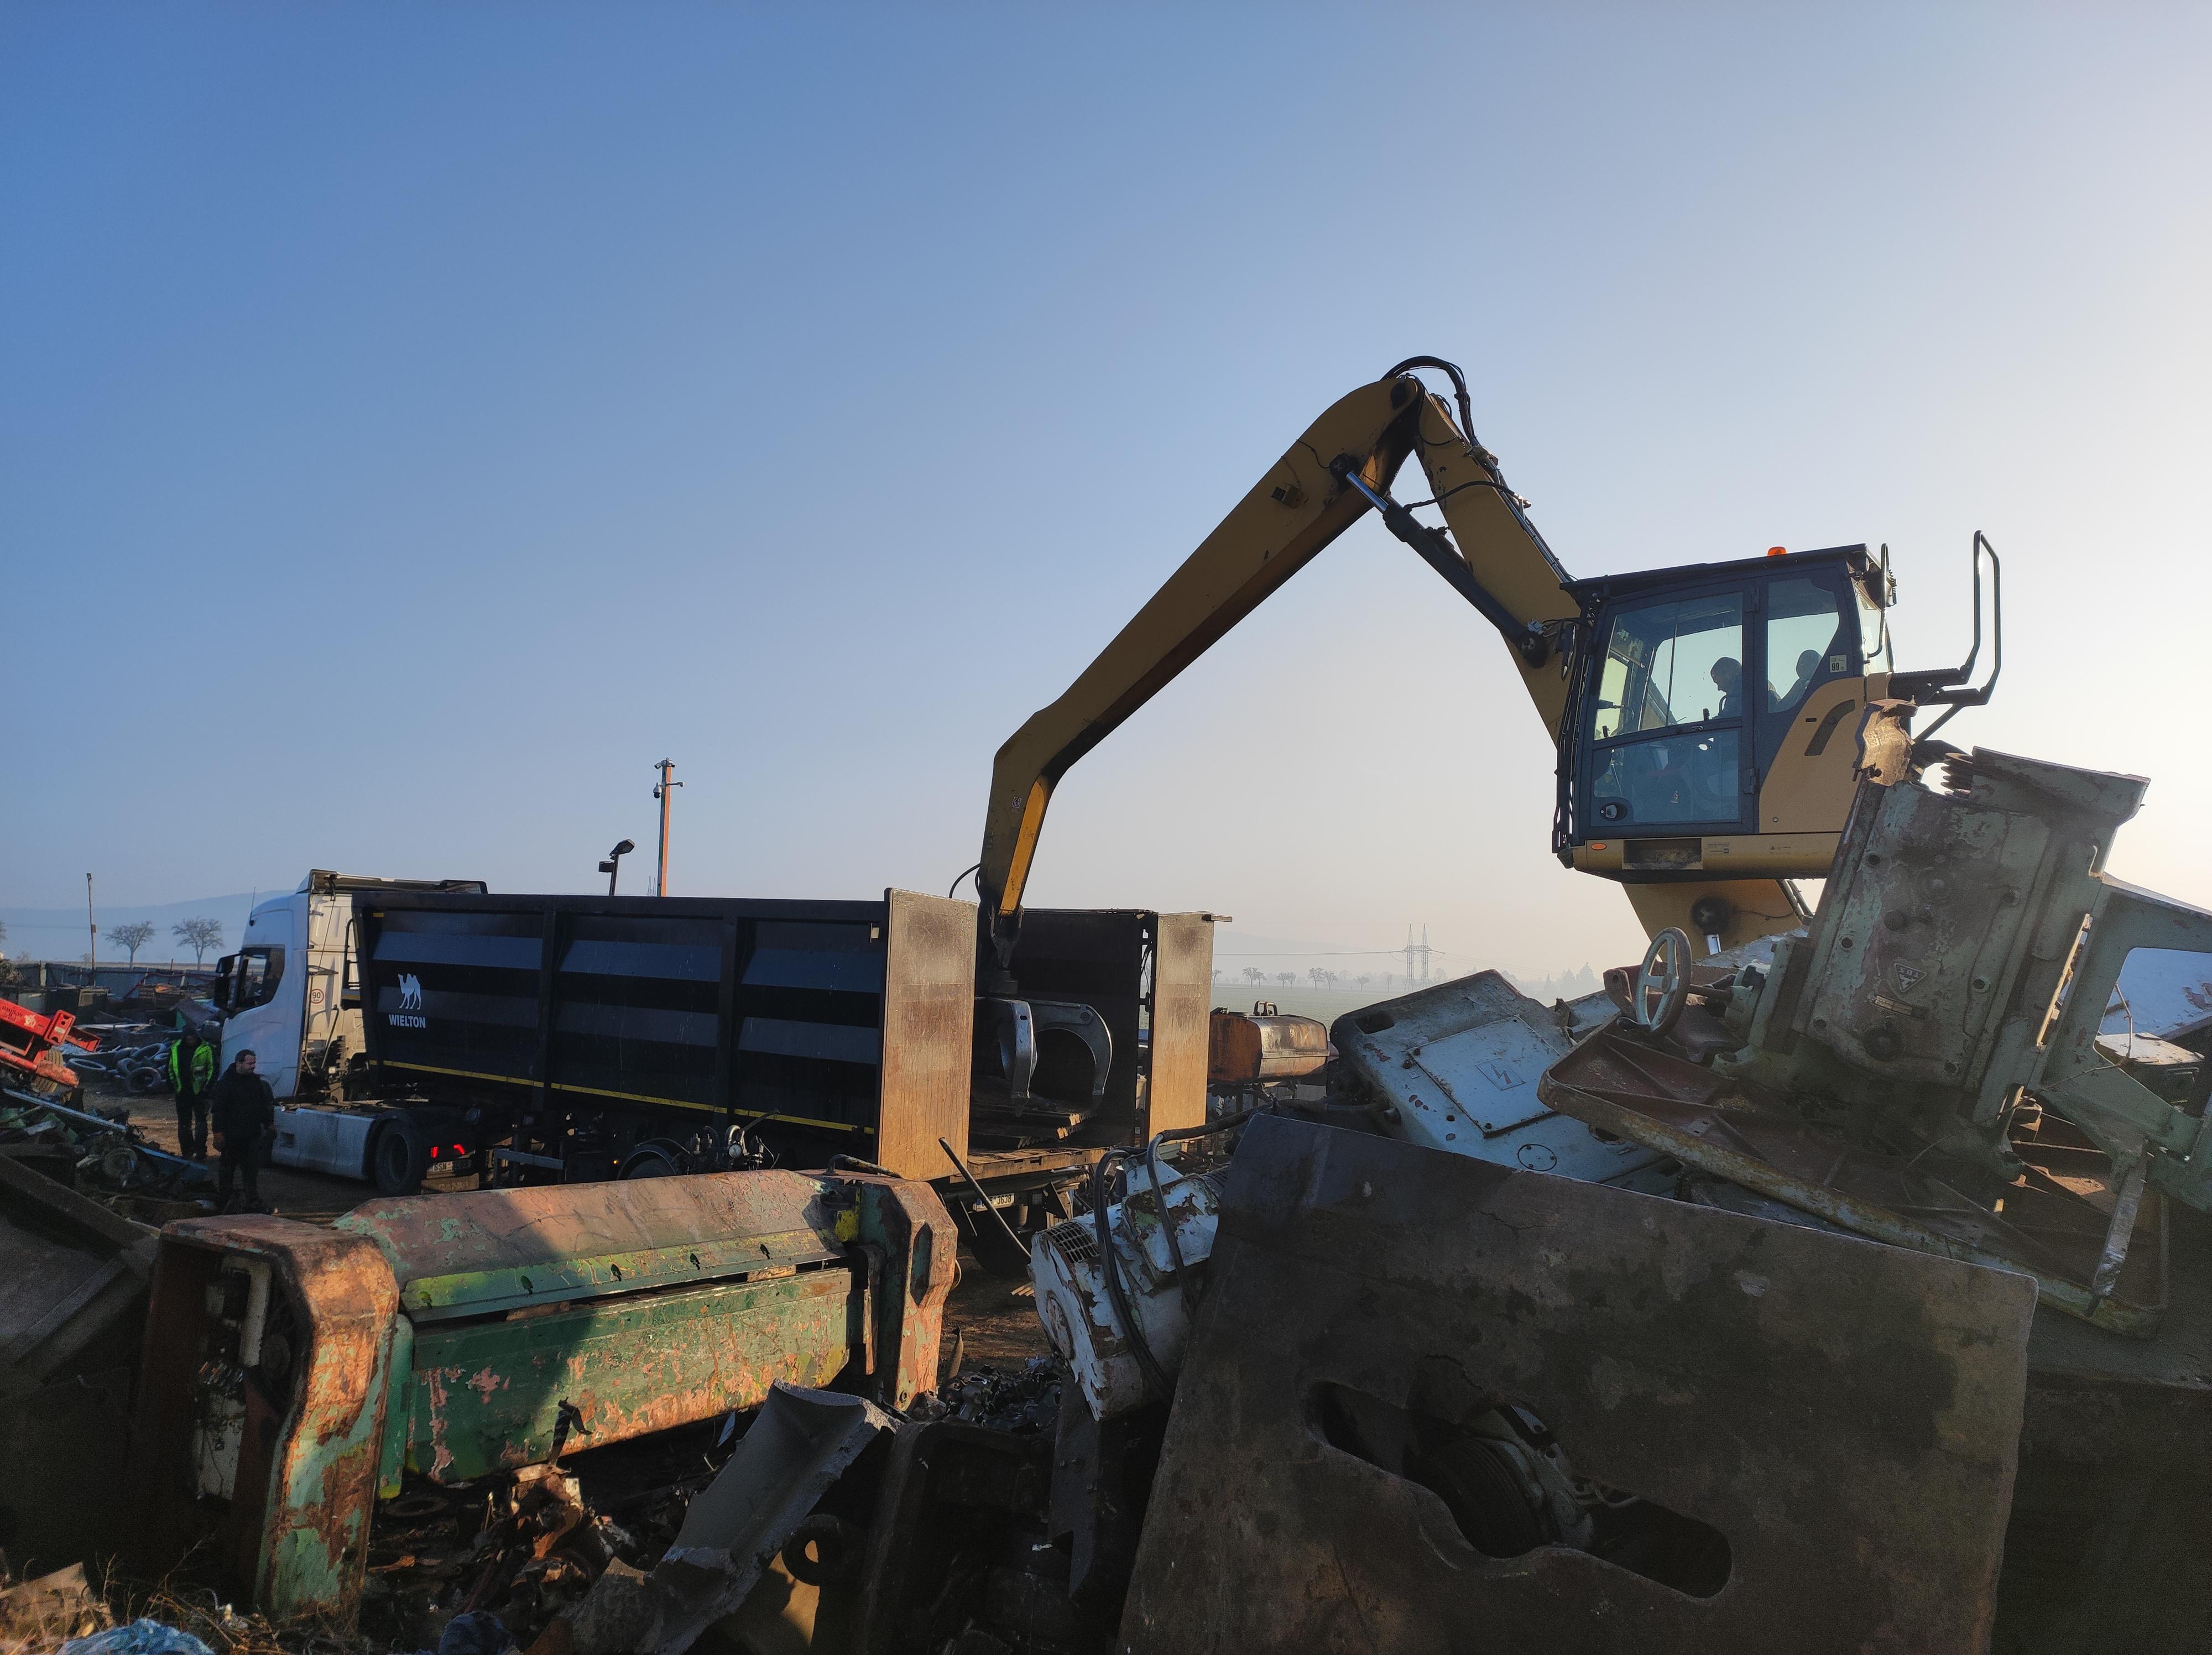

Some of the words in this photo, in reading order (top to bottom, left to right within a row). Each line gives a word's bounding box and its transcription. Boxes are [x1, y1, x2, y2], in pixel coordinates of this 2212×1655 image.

[1832, 662, 1839, 671] 99
[389, 1014, 426, 1028] WIELTON
[997, 1194, 1011, 1205] 3638
